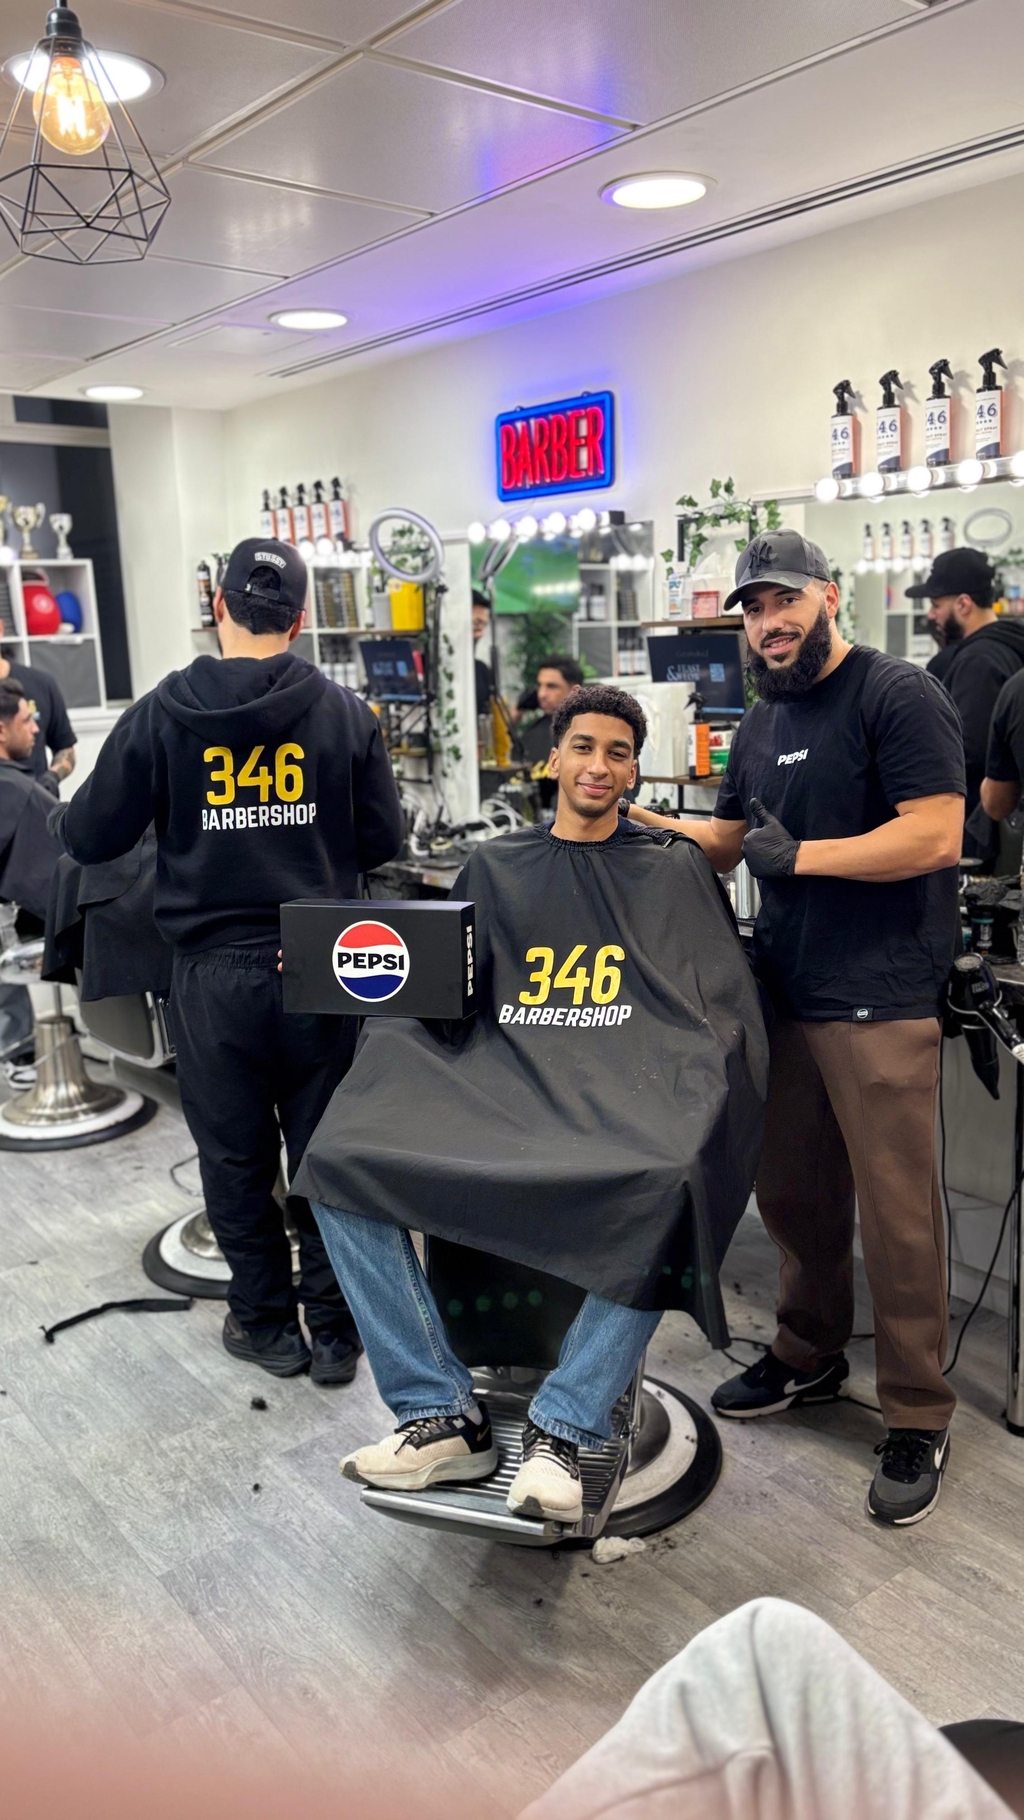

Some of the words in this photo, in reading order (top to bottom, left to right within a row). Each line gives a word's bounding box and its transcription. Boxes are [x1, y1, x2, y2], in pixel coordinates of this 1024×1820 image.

[500, 406, 605, 489] BARBER
[203, 742, 305, 806] 346
[777, 748, 809, 766] PEPSI
[201, 802, 317, 831] BARBERSHOP
[337, 952, 405, 971] PEPSI
[466, 925, 474, 997] PEPSI
[518, 944, 625, 1006] 346
[498, 1004, 632, 1028] BARBERSHOP
